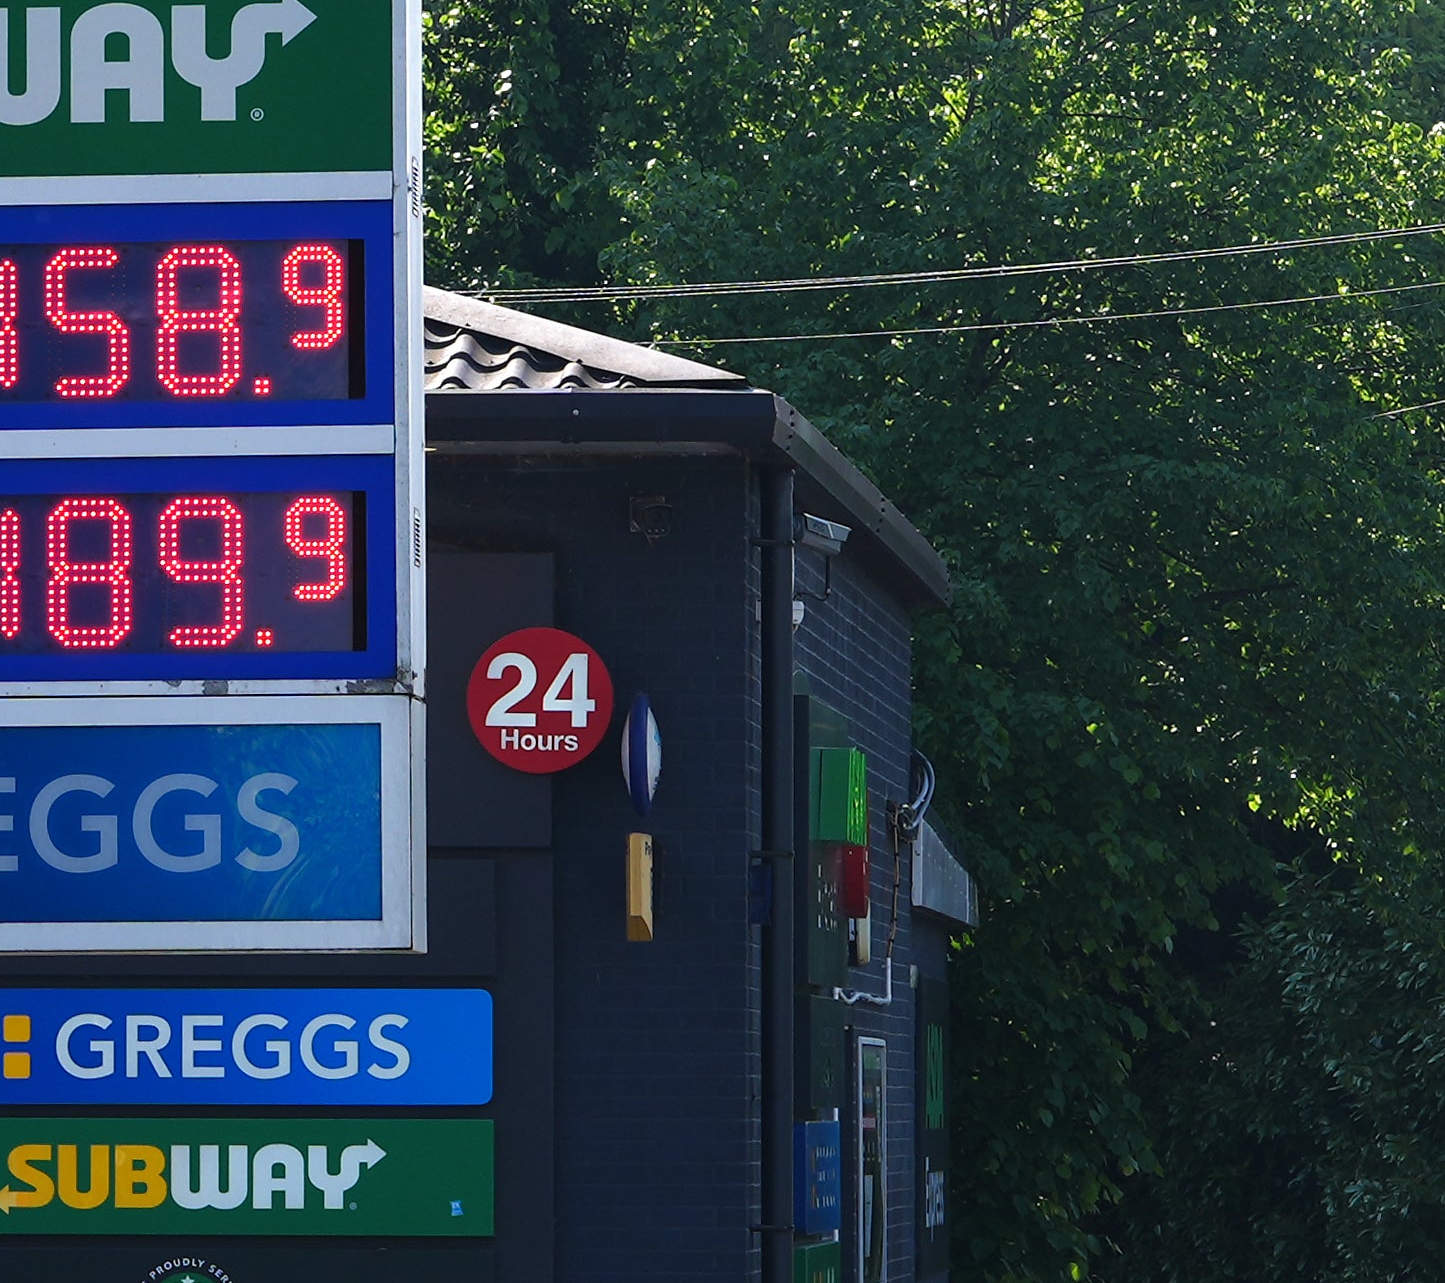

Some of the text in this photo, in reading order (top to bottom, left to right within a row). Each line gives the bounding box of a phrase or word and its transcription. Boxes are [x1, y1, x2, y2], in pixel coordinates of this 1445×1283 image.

[485, 652, 596, 729] 24
[499, 728, 579, 753] Hours
[55, 1014, 411, 1081] GREGGS
[148, 1258, 206, 1280] PROUDLY
